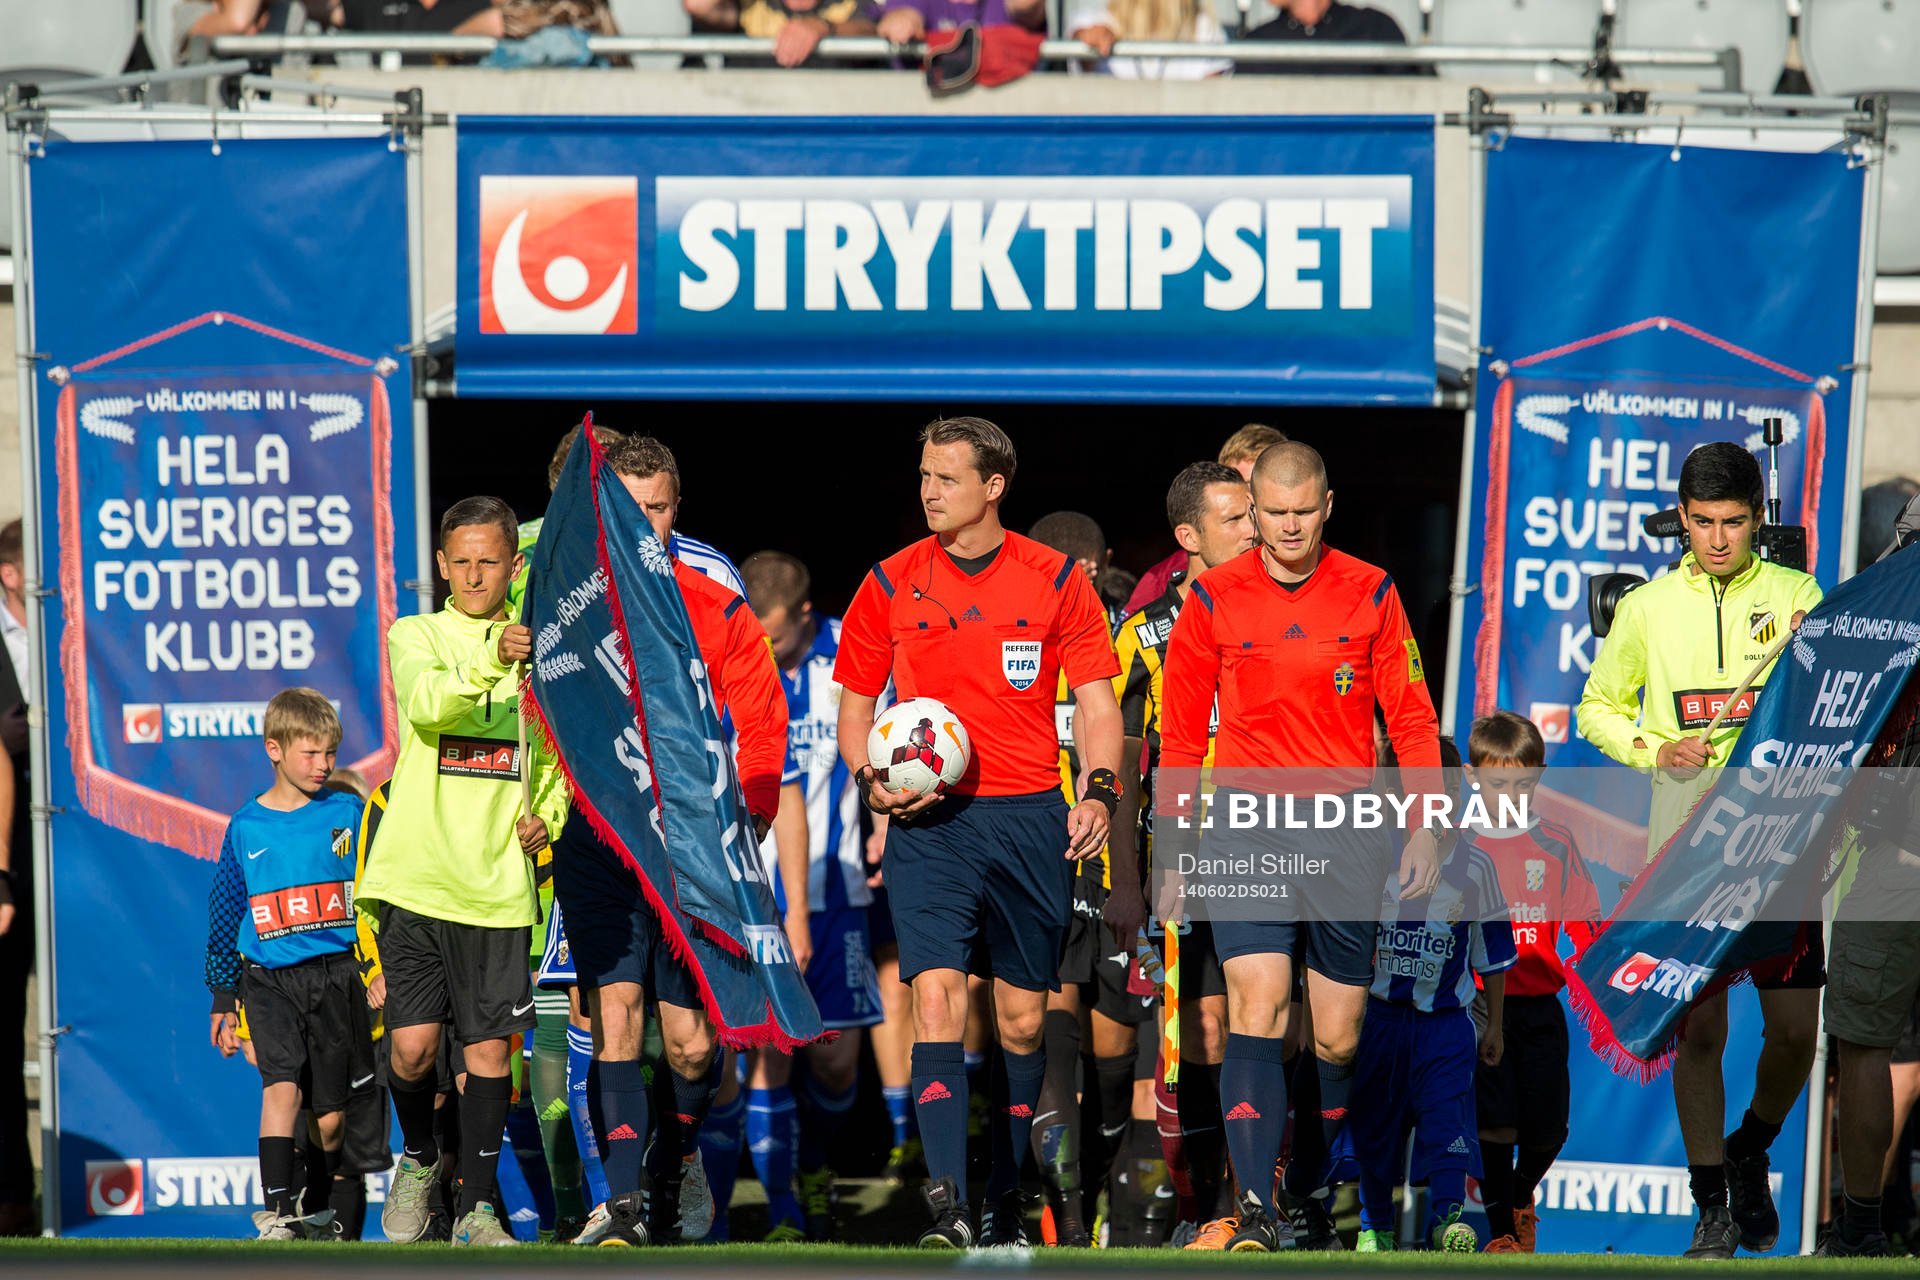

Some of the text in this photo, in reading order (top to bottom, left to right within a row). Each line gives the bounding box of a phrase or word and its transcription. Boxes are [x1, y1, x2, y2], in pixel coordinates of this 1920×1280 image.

[679, 199, 1389, 312] STRYKTIPSET
[146, 387, 297, 412] VÄLKOMMEN IN I
[1583, 389, 1735, 421] VÄLKOMMEN IN I
[157, 434, 290, 486] HELA
[1588, 437, 1685, 492] HEL
[98, 495, 353, 550] SVERIGES
[94, 556, 362, 611] FOTBOLLS
[1832, 611, 1896, 641] VÄLKOMMEN
[145, 618, 315, 672] KLUBB
[1008, 660, 1036, 671] FIFA
[1378, 948, 1437, 979] Finans
[918, 1090, 952, 1105] adidas
[1225, 1110, 1261, 1121] adidas
[606, 1132, 638, 1141] adidas
